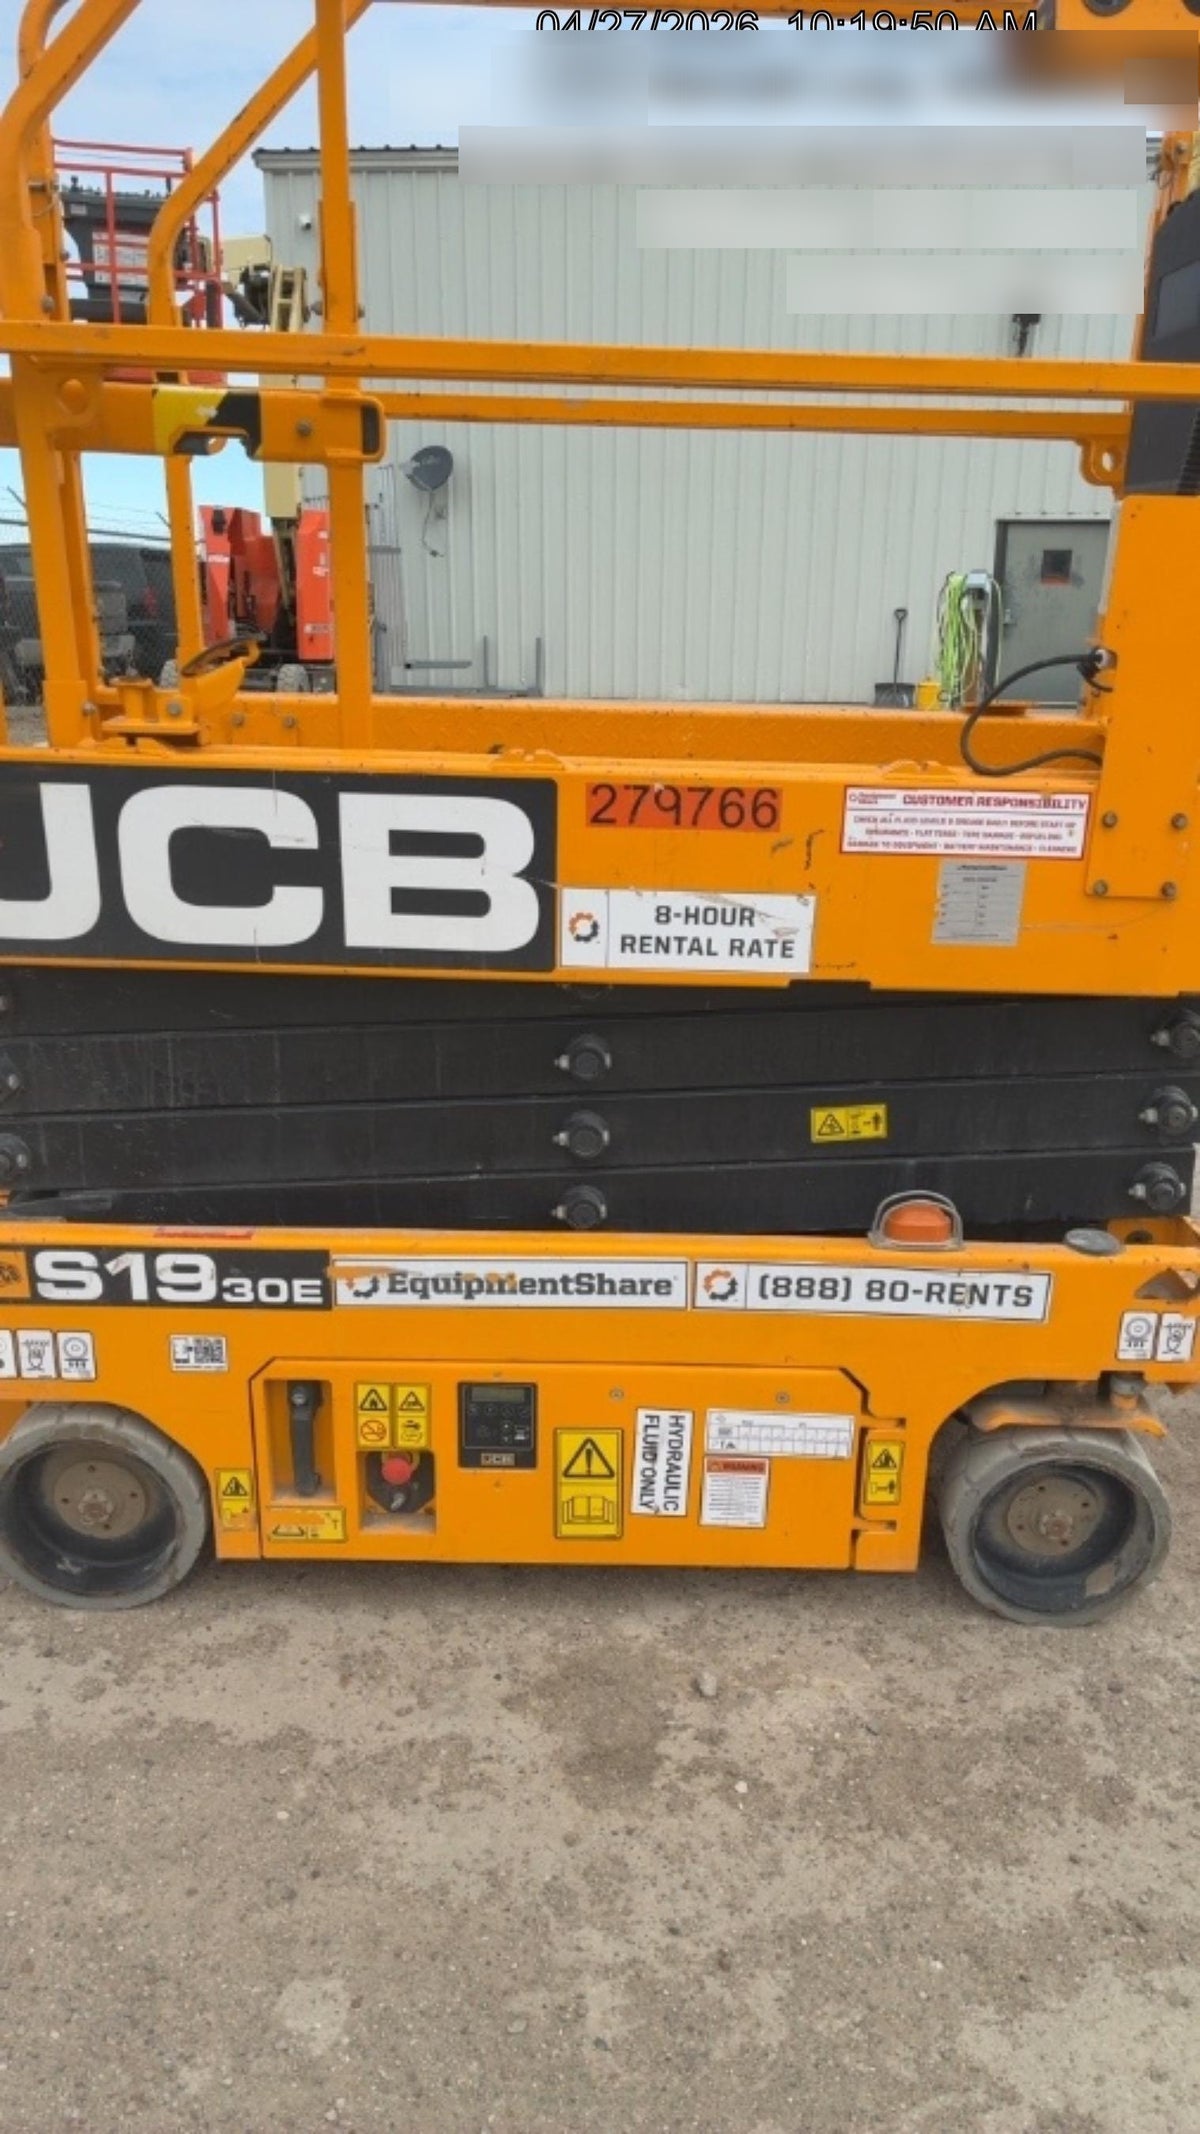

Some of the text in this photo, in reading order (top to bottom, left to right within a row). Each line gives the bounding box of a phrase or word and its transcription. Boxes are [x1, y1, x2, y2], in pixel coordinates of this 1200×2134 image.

[590, 784, 778, 829] 279766
[902, 794, 974, 807] CUSTOMER
[976, 796, 1087, 810] RESPONSIBILITY
[0, 782, 540, 953] JCB
[654, 905, 756, 928] 8-HOUR
[620, 935, 795, 959] RENTAL RATE
[758, 1274, 1034, 1308] (888) 80-RENTS
[639, 1415, 660, 1510] FLUID ONLY
[663, 1415, 686, 1512] HYDRAULIC
